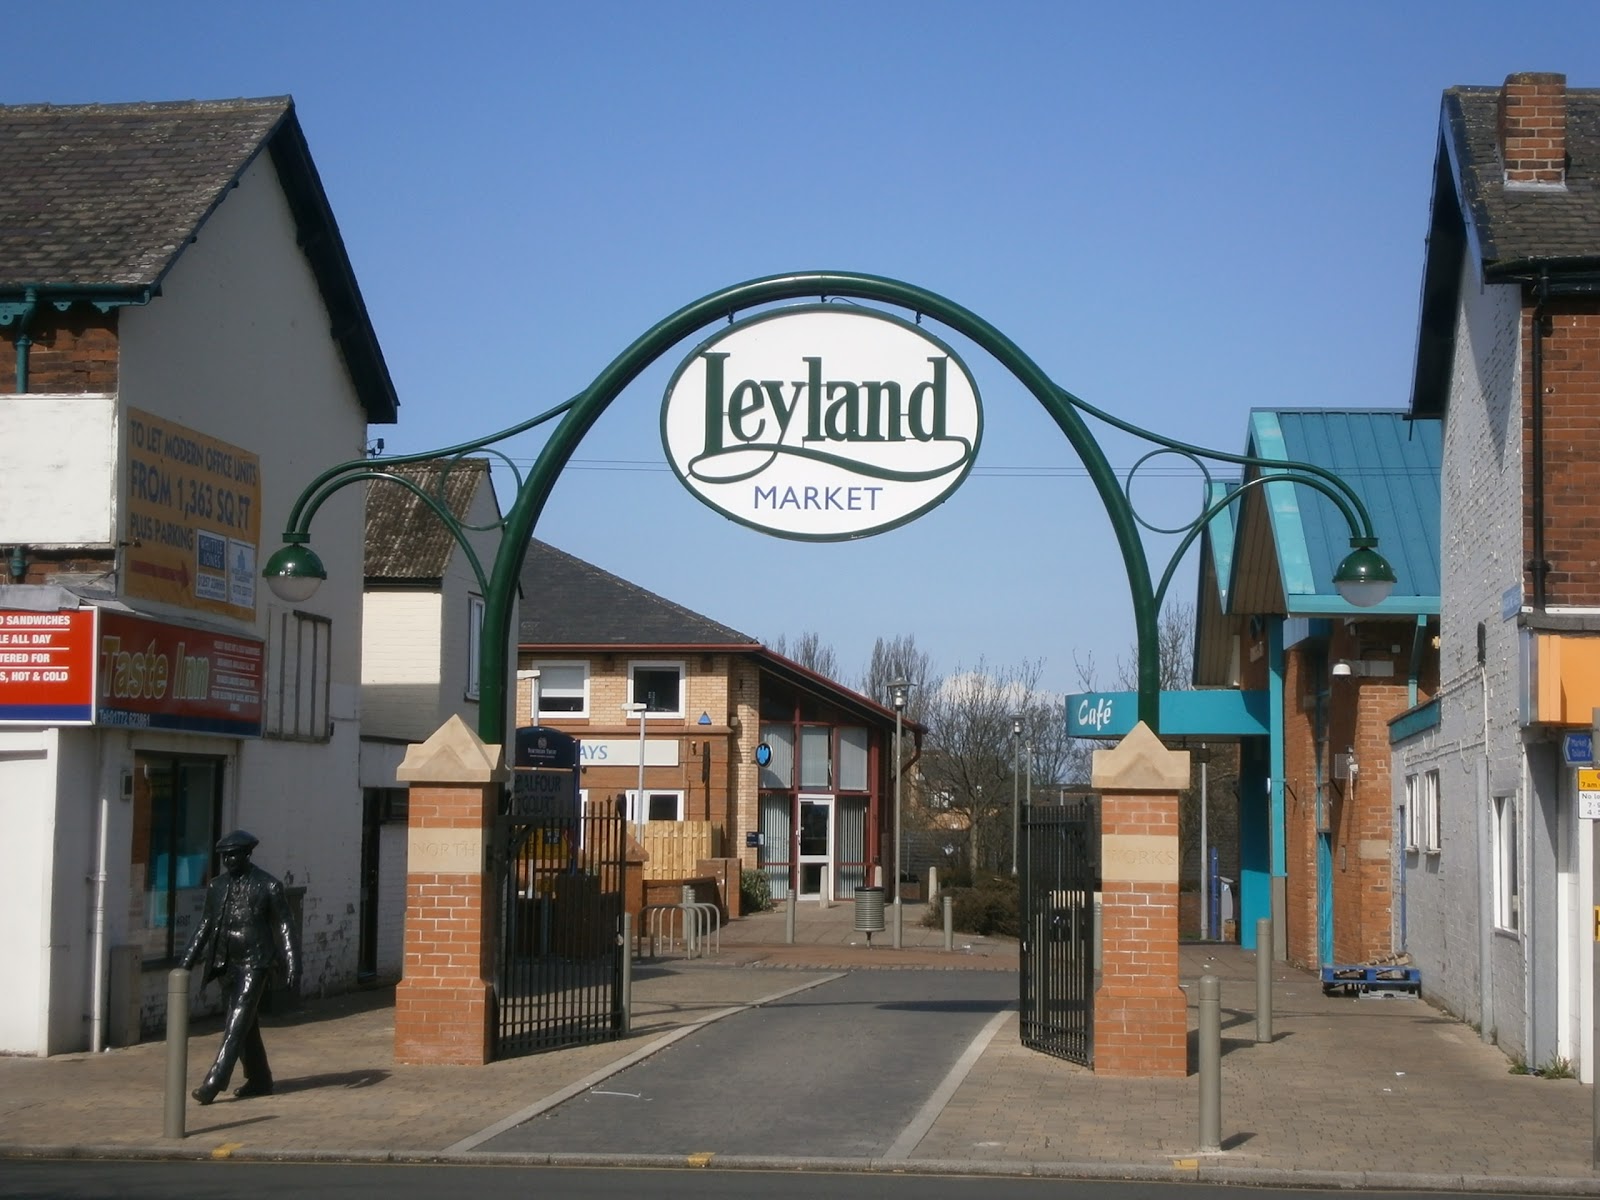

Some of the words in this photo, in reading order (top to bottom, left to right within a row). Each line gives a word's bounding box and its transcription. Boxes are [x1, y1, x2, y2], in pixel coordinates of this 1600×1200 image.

[688, 352, 972, 484] Leyland
[131, 419, 144, 448] TO
[146, 427, 162, 454] LET
[164, 434, 204, 467] MODERN
[206, 447, 232, 479] OFFICE
[234, 457, 256, 487] UNITS
[131, 460, 171, 508] FROM
[177, 476, 213, 521] 1,363
[217, 488, 234, 527] SQ
[238, 495, 251, 530] FT
[754, 486, 883, 511] MARKET
[130, 512, 153, 540] PLUS
[155, 518, 193, 551] PARKING
[6, 616, 71, 625] SANDWICHES
[11, 634, 30, 644] ALL
[32, 634, 52, 644] DAY
[31, 653, 50, 663] FOR
[102, 635, 169, 700] Taste
[172, 641, 210, 700] Inn
[11, 671, 30, 681] HOT
[32, 671, 41, 681] &
[42, 671, 68, 681] COLD
[1078, 698, 1113, 731] Café
[579, 745, 608, 760] AYS
[412, 842, 477, 857] NORTH
